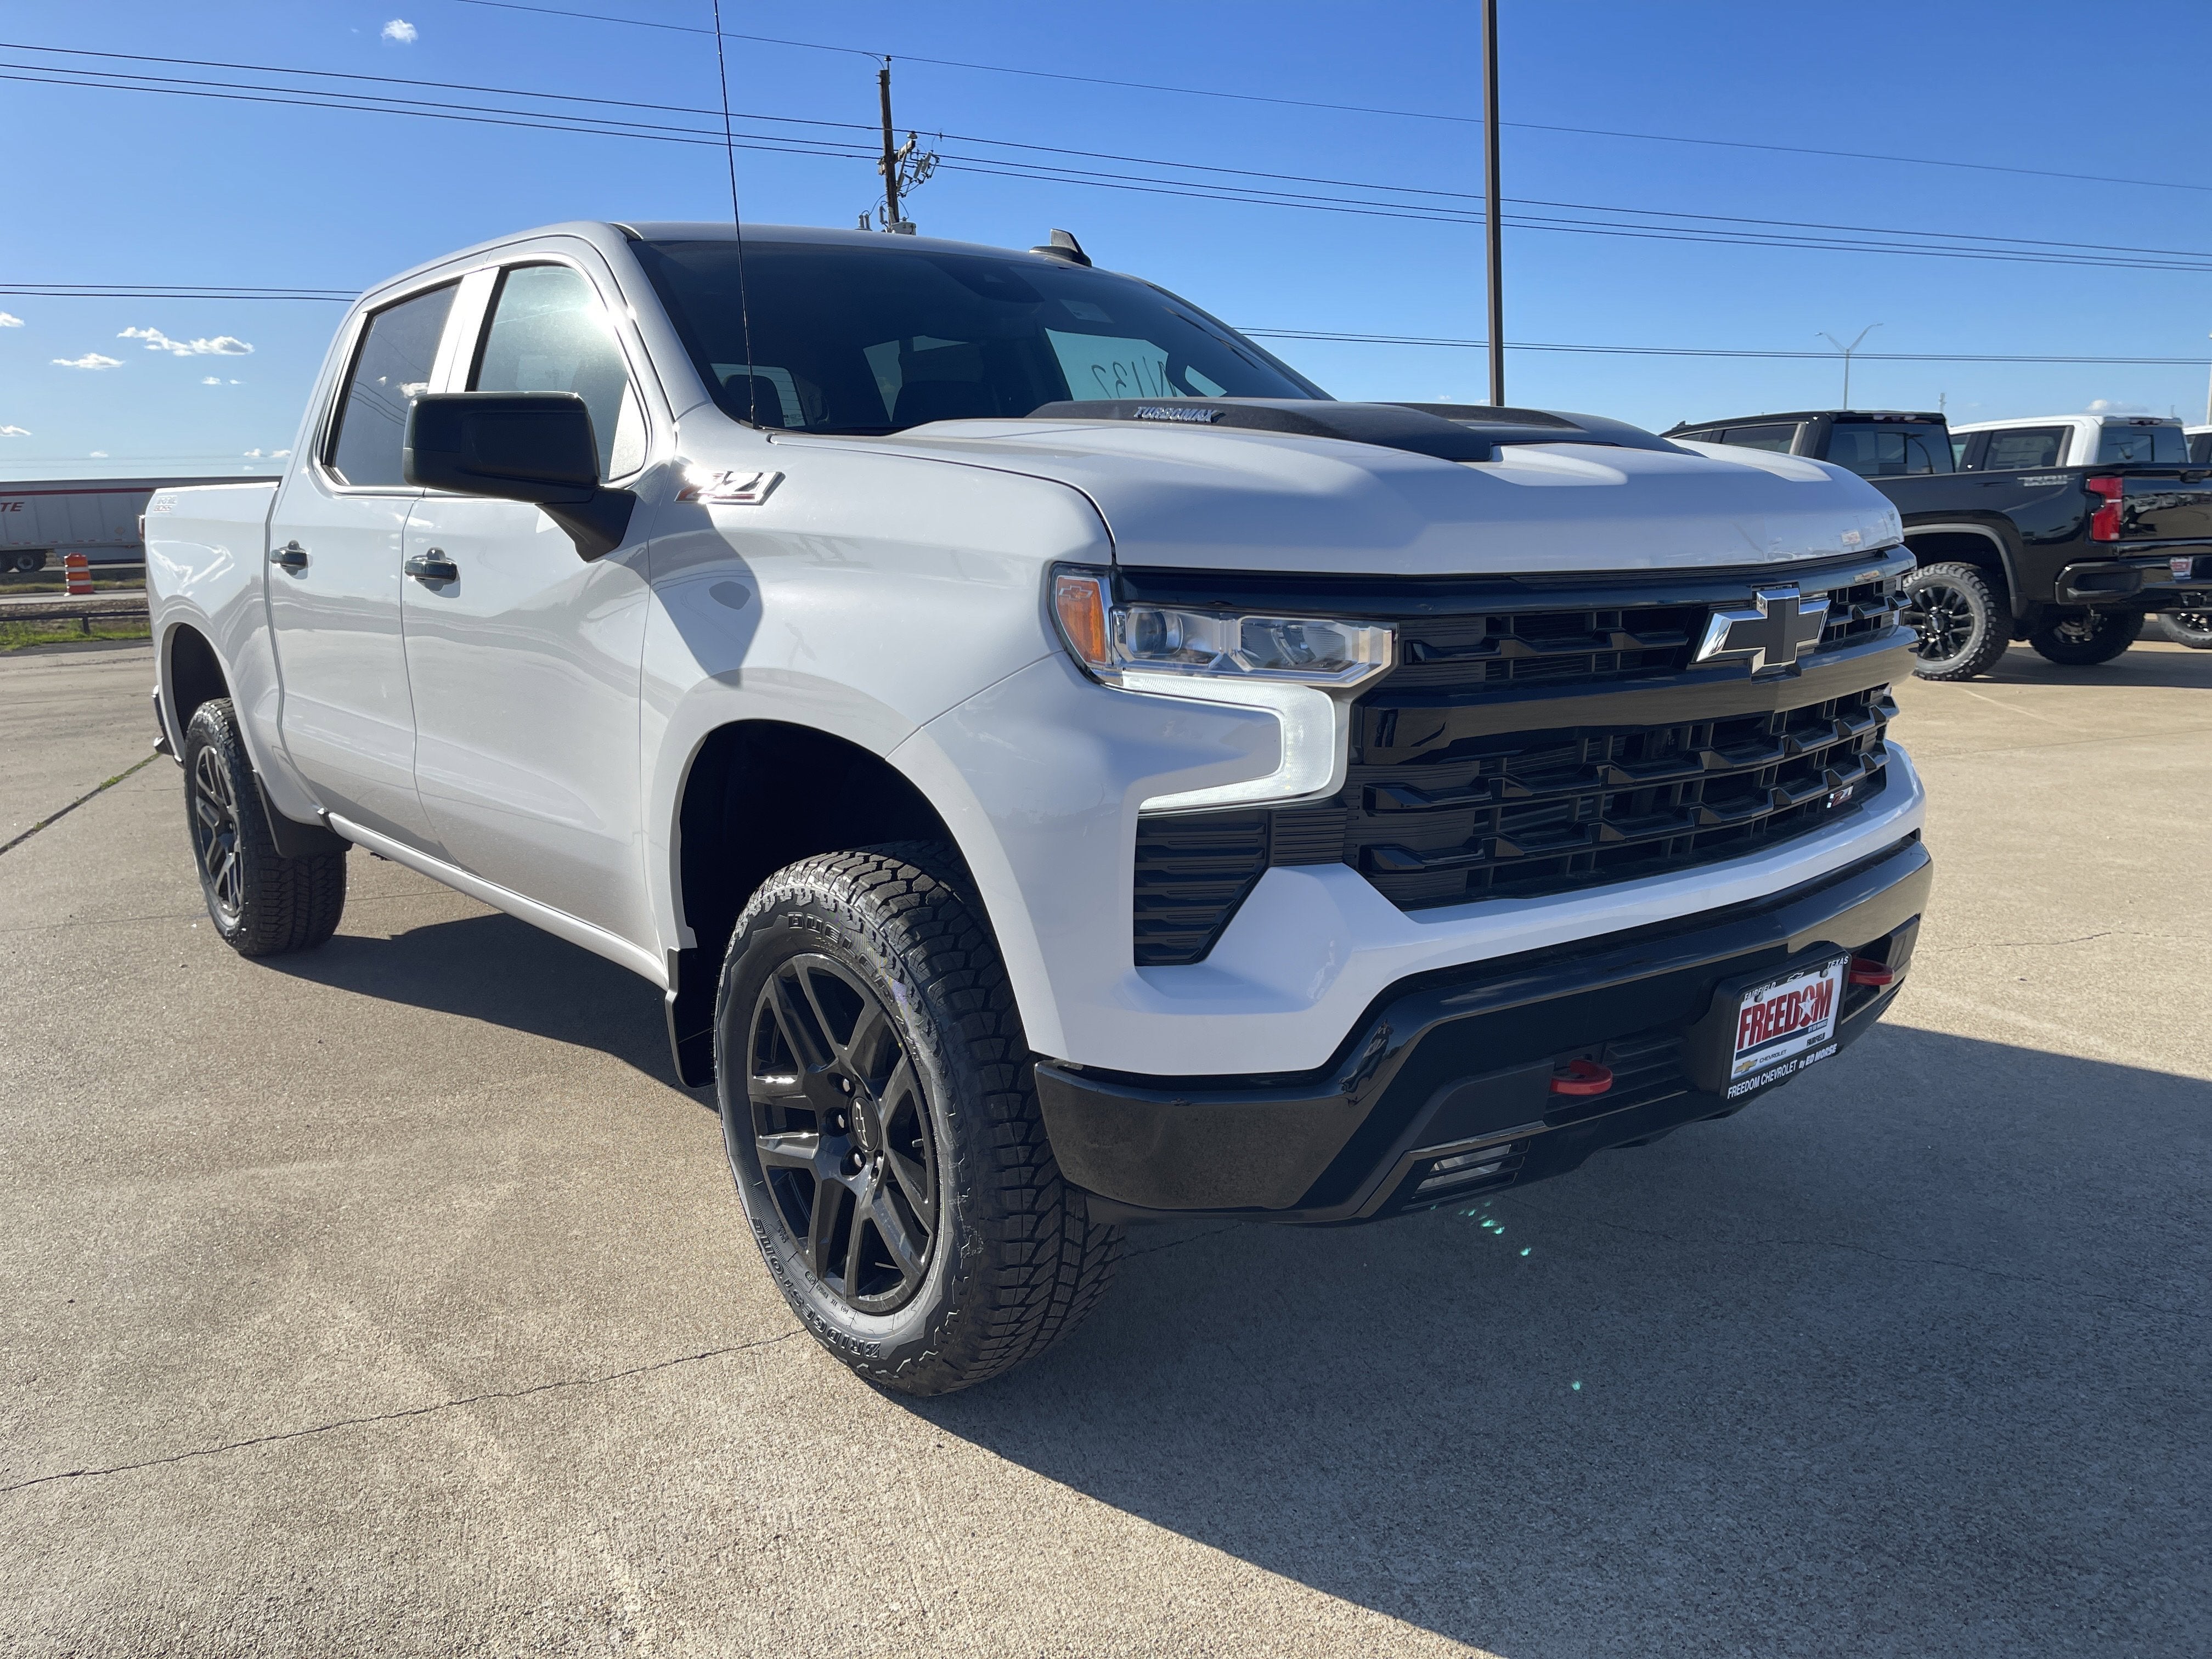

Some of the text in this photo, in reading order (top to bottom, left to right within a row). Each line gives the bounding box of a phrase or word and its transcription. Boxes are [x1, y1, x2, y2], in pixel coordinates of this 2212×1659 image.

[1744, 956, 1849, 1001] FAIRFIELD TEXAS
[1736, 978, 1834, 1051] FREEDOM
[1759, 1049, 1787, 1063] CHEVROLET
[1727, 1075, 1760, 1099] FREEDOM
[1760, 1059, 1798, 1086] CHEVROLET
[751, 1215, 881, 1360] BRIDGESTONE
